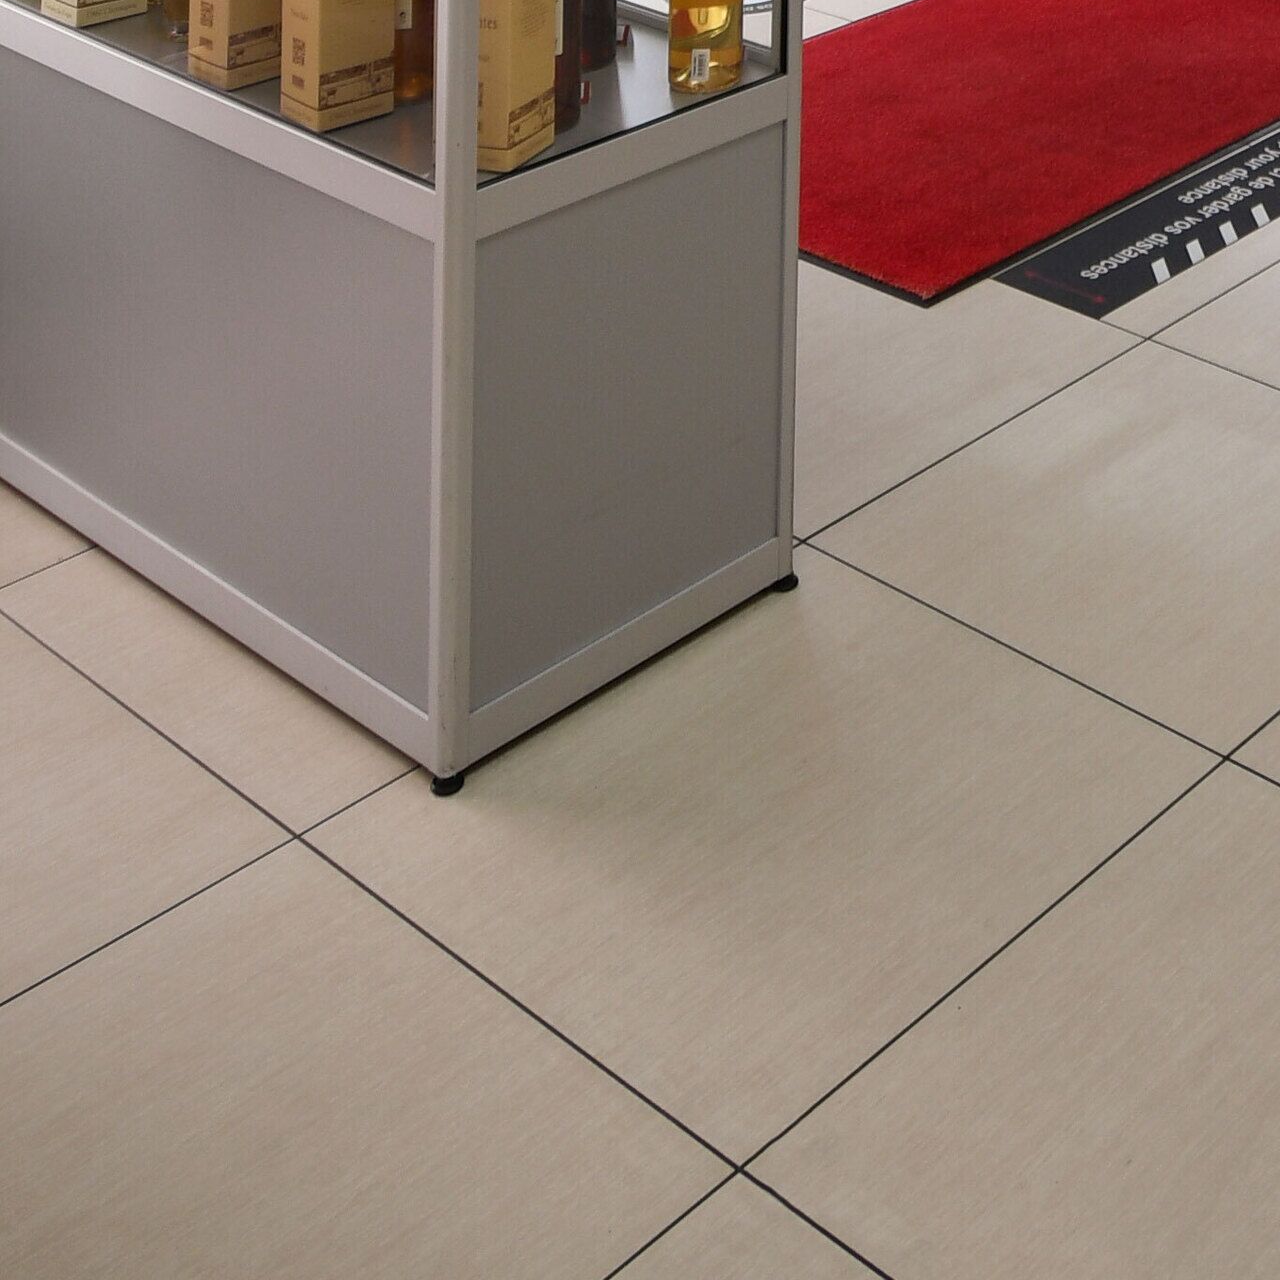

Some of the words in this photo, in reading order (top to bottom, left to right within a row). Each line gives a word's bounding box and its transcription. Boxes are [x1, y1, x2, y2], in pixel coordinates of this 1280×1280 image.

[1177, 166, 1248, 204] distance
[1249, 175, 1275, 191] de
[1198, 185, 1252, 219] garder
[1164, 215, 1202, 235] vos
[1080, 232, 1169, 280] distances
